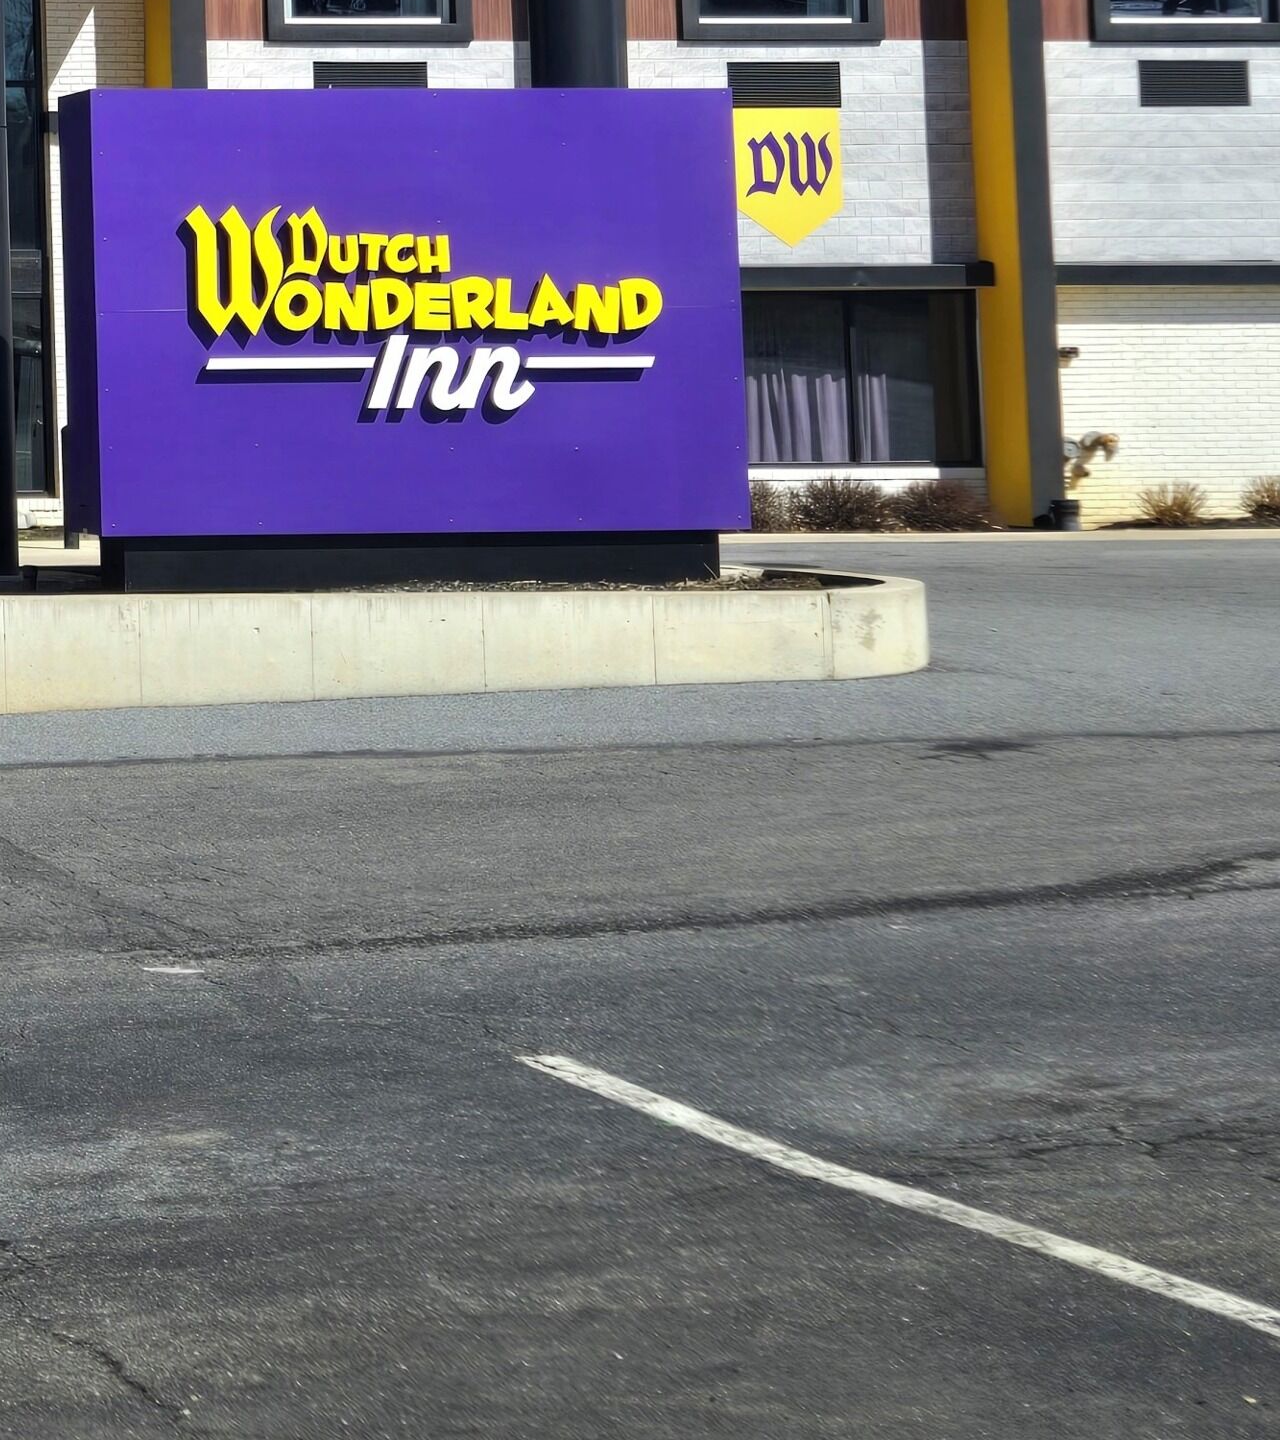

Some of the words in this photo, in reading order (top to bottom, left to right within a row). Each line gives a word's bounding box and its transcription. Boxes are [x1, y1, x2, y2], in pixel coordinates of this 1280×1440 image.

[745, 130, 833, 198] DW
[184, 203, 665, 337] WONDERLAND
[282, 205, 451, 277] DUTCH
[366, 333, 537, 412] Inn
